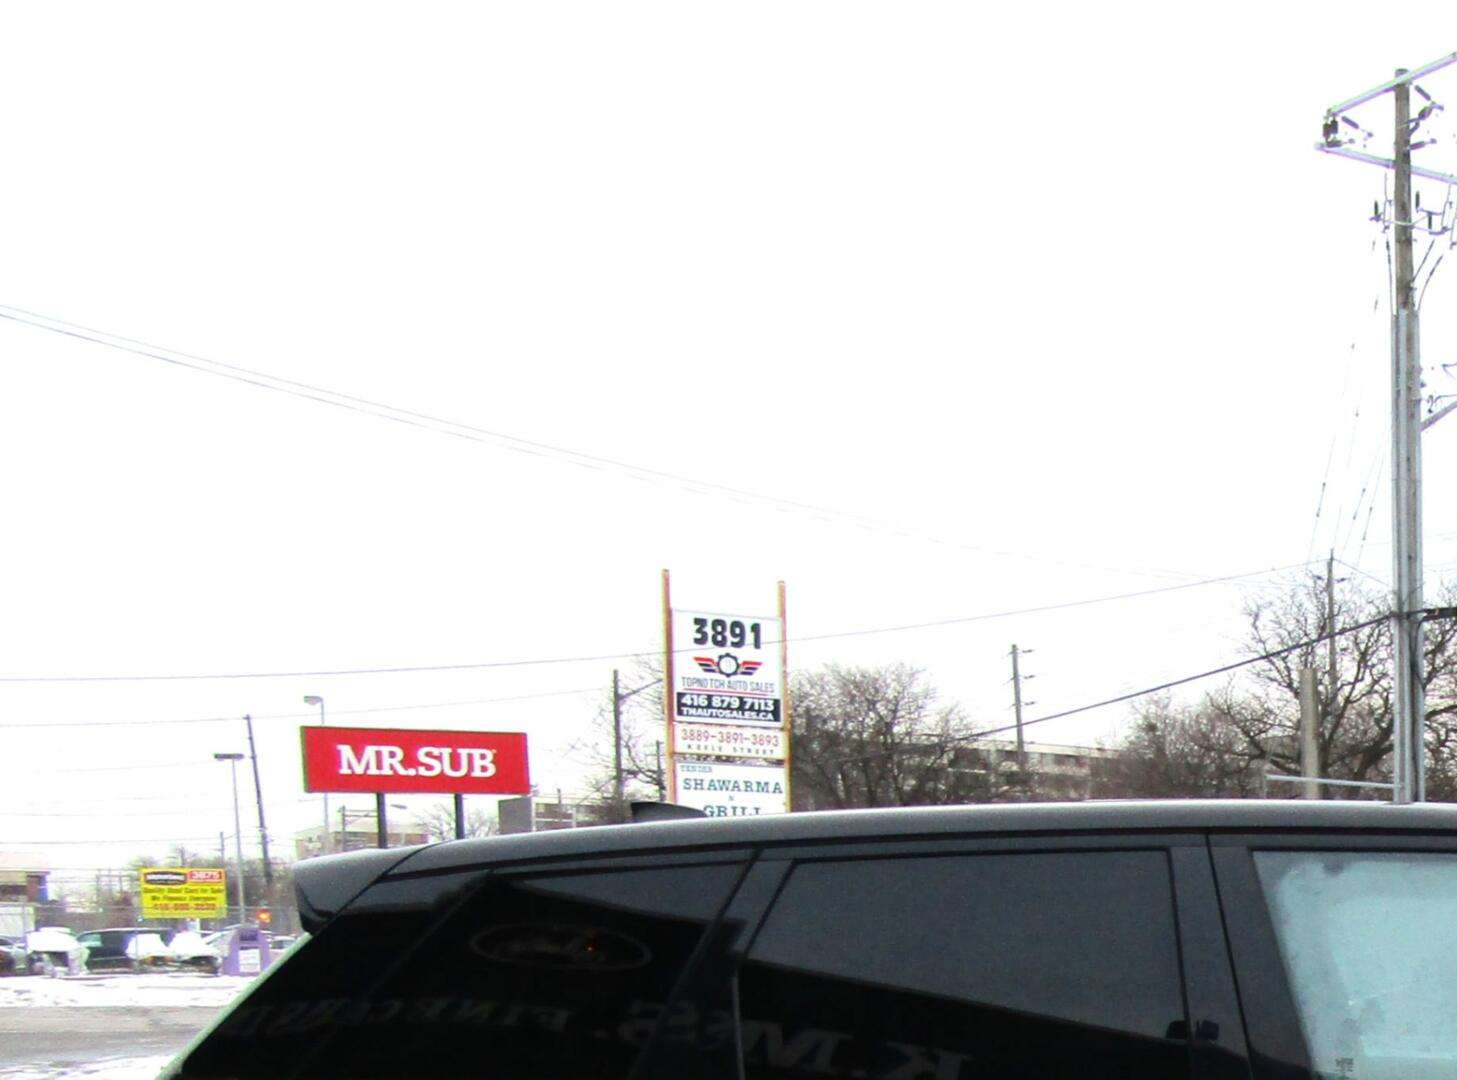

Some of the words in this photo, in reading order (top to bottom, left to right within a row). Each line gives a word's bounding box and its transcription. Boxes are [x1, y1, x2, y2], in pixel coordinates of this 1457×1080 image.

[693, 617, 762, 650] 3891
[727, 679, 748, 691] AUTO
[750, 681, 774, 693] SALES
[681, 694, 708, 707] 416
[711, 696, 740, 709] 879
[743, 698, 774, 712] 7113
[683, 778, 784, 794] SHAWARMA
